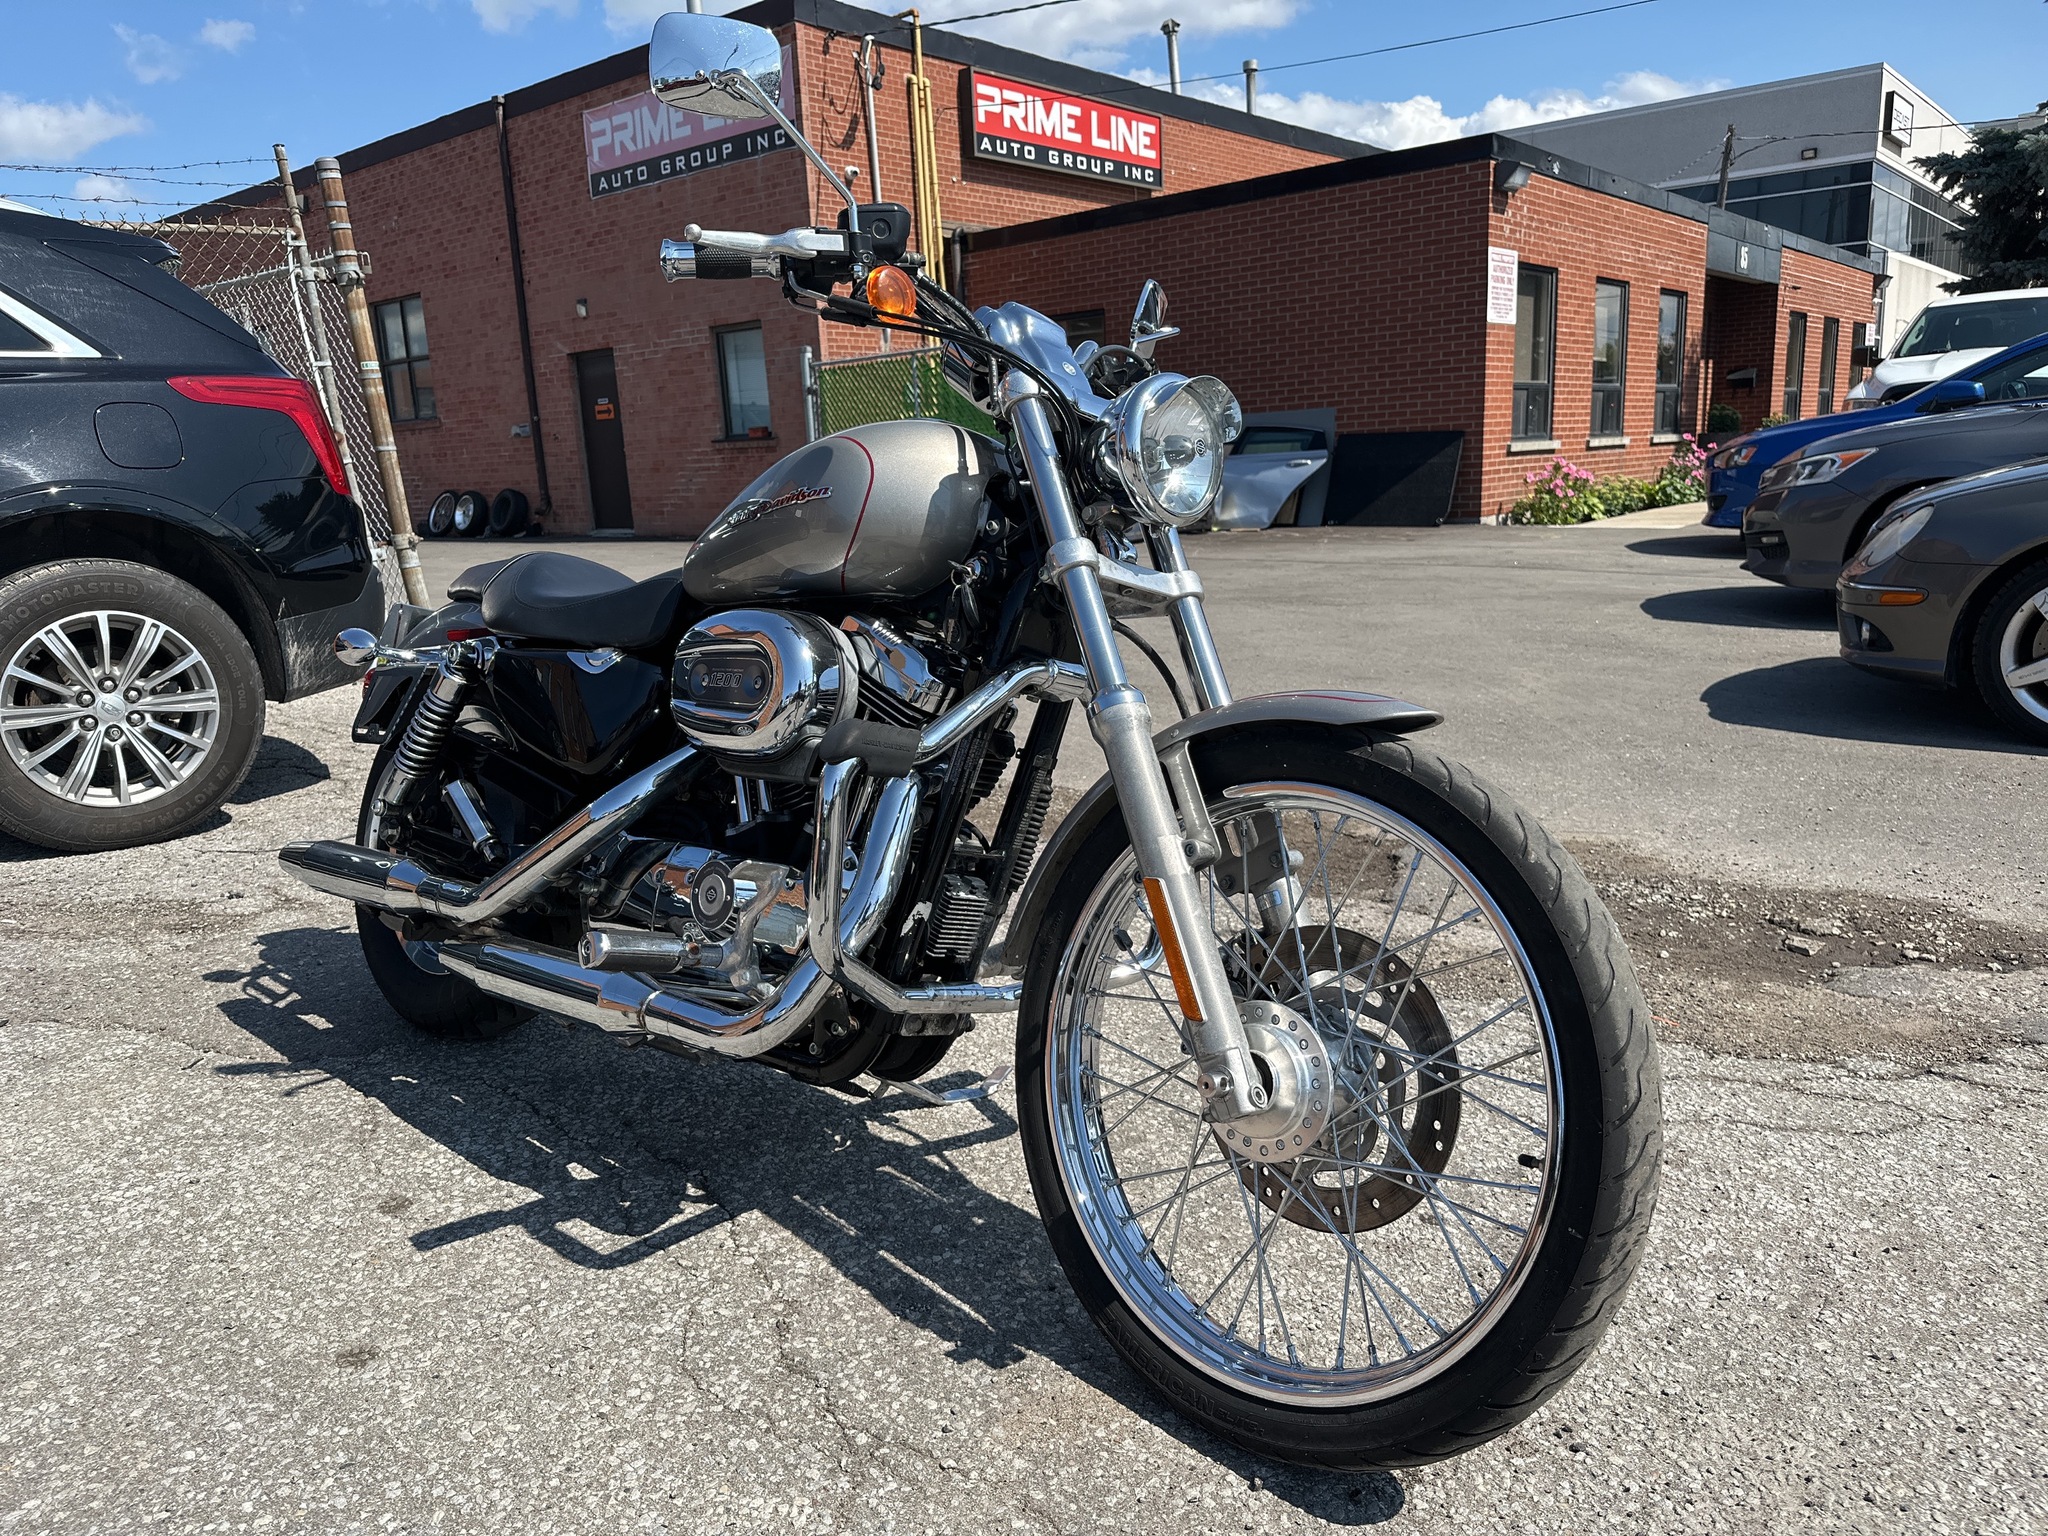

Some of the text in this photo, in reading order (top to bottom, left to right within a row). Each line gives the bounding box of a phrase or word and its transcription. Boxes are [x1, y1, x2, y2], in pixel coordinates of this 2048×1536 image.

[590, 106, 692, 162] PRIME
[976, 83, 1157, 159] PRIME LINE
[598, 129, 786, 191] AUTO GROUP INC
[980, 137, 1154, 182] AUTO GROUP INC
[1, 581, 139, 630] MOTOMASTER
[199, 620, 226, 650] HYDRA
[225, 652, 241, 679] EDGE
[236, 682, 248, 710] TOUR
[709, 672, 743, 688] 1200
[1108, 1320, 1216, 1415] AMERICAN
